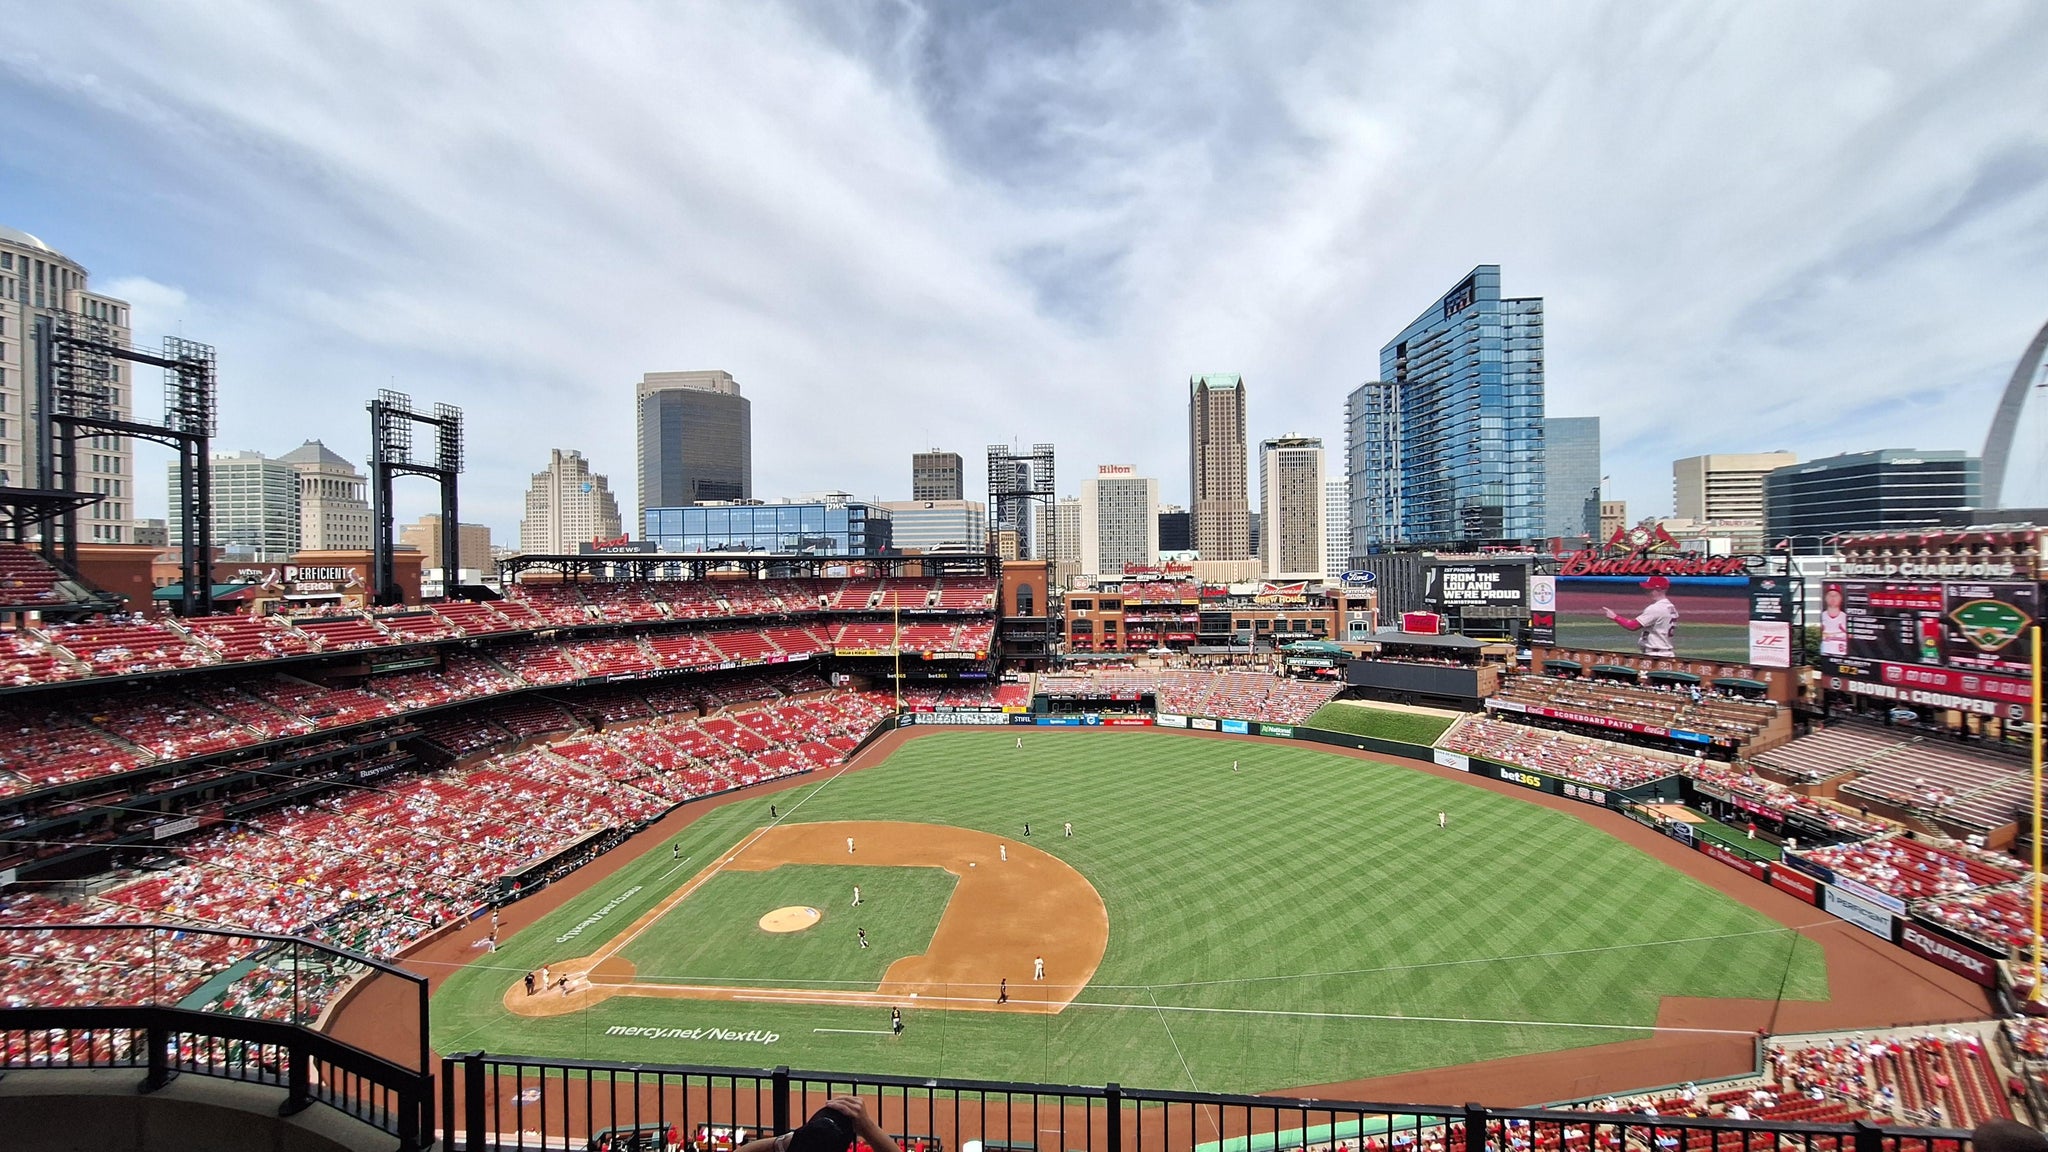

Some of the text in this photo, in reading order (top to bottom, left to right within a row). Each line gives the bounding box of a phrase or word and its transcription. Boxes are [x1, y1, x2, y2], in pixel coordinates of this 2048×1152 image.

[1099, 465, 1130, 473] Hilton
[826, 502, 848, 511] pwc
[592, 533, 629, 551] Live!
[1161, 561, 1192, 574] Nation
[1554, 550, 1746, 575] Budweiser
[286, 565, 347, 581] PERFICIENT
[1347, 572, 1369, 580] Ford
[1840, 563, 2015, 576] WORLD CHAMPIONS
[1443, 573, 1500, 582] FROM THE
[296, 583, 334, 591] PERCH
[1261, 586, 1301, 595] Budweiser
[1443, 582, 1492, 590] LOU AND
[1443, 590, 1520, 599] WE'RE PROUD
[1848, 680, 1896, 698] BROWN
[1899, 690, 1909, 701] &
[1911, 690, 1997, 715] CROUPPEN
[1554, 711, 1605, 725] SCOREBOARD
[1608, 719, 1634, 729] PATIO
[1644, 725, 1666, 735] Coca-Cola
[1500, 767, 1541, 787] bet365
[1836, 897, 1890, 926] PERFICIENT
[1902, 928, 1986, 975] EQUIFAX
[605, 1025, 780, 1045] mercy.net/NextUp
